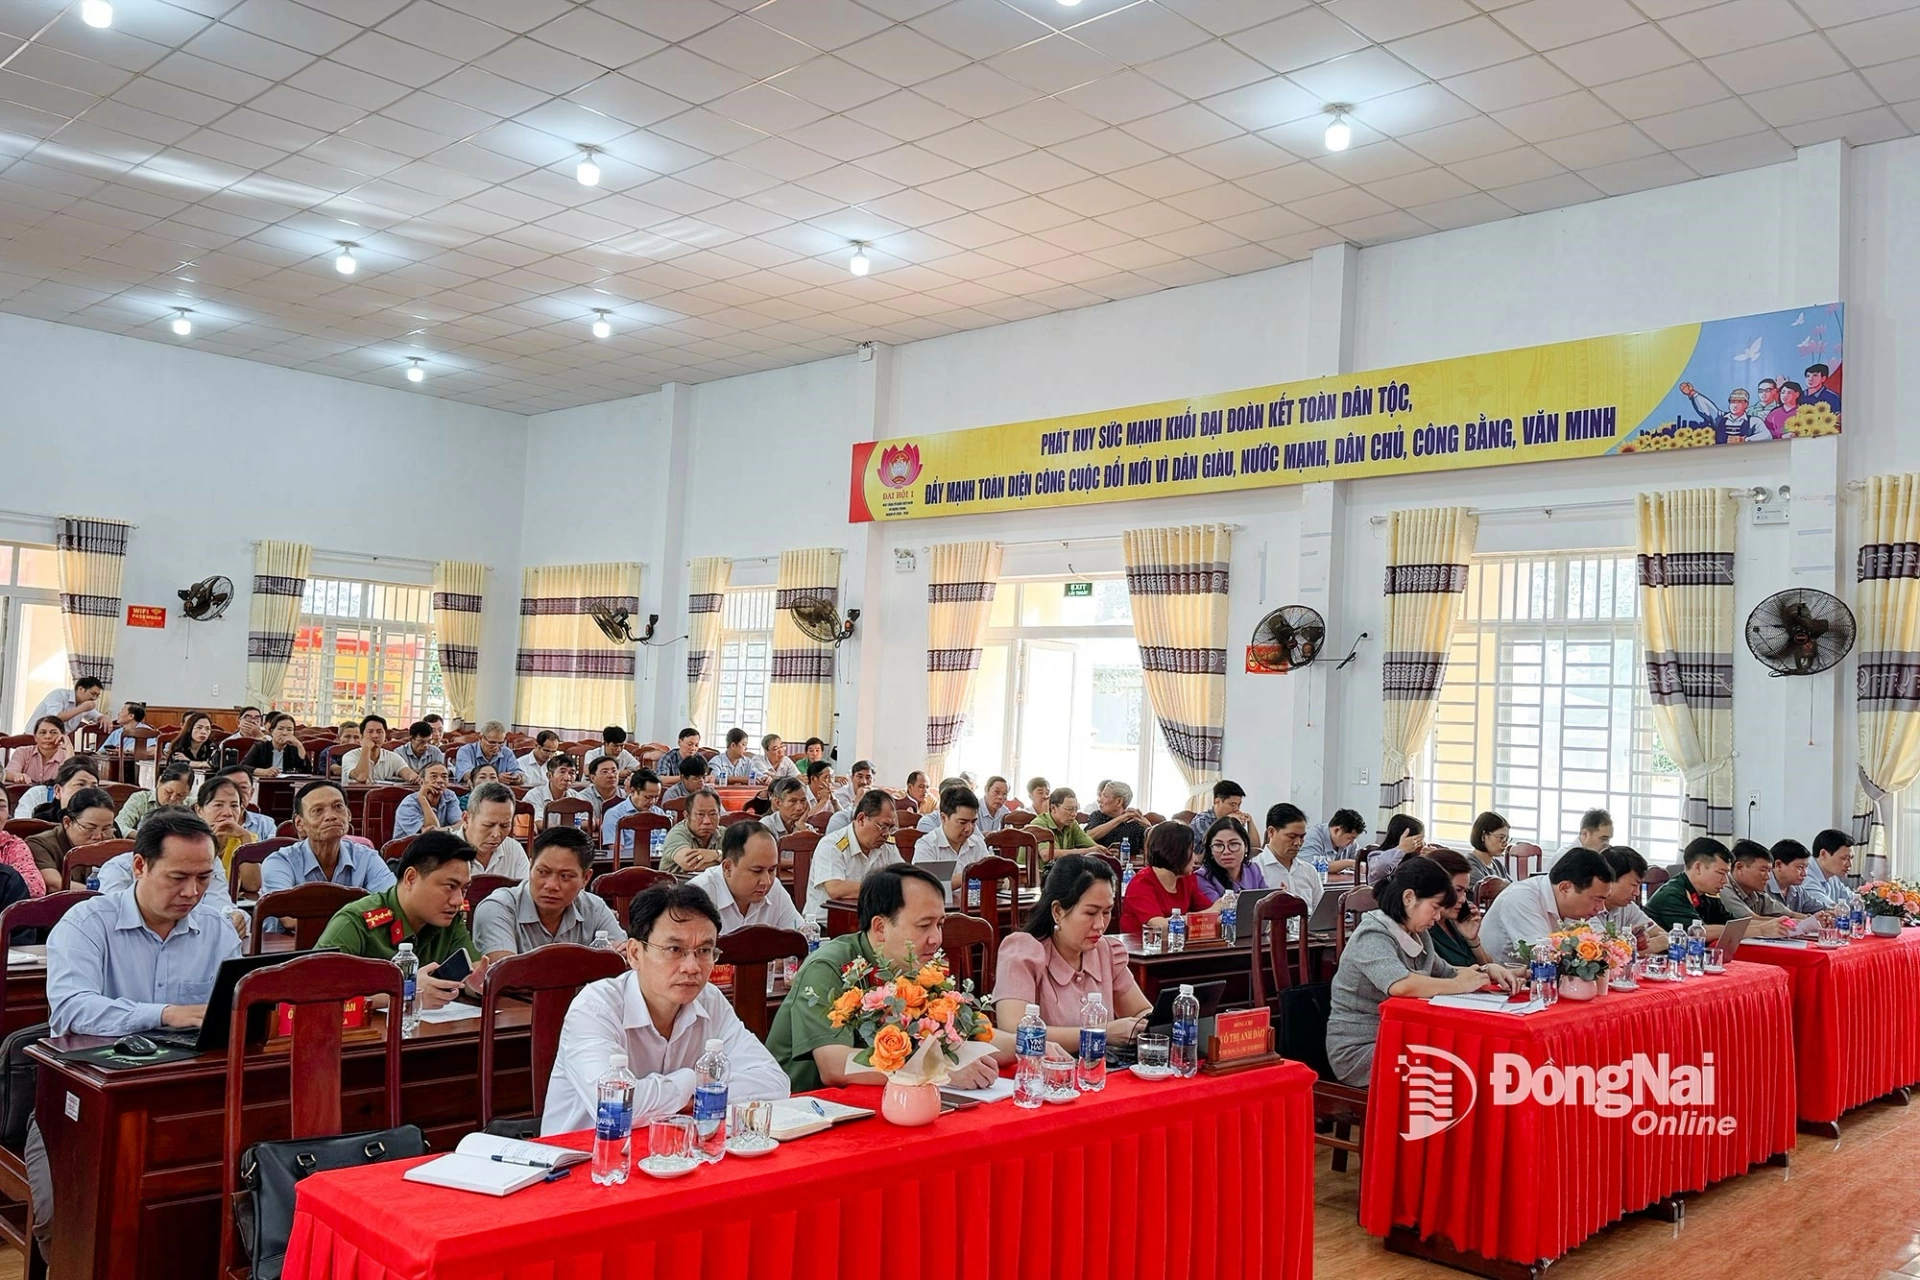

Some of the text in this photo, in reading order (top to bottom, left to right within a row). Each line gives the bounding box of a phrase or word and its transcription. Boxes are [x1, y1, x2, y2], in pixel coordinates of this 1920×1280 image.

[924, 407, 1617, 507] ĐẨY MẠNH TOÀN DIỆN CÔNG CUỘC ĐỔI MỚI VÌ DÂN GIÀU, NƯỚC MẠNH, DÂN CHỦ, CÔNG BẰNG, VĂN MINH
[1040, 380, 1413, 456] PHÁT HUY SỨC MẠNH KHỐI ĐẠI ĐOÀN KẾT TOÀN DÂN TỘC,
